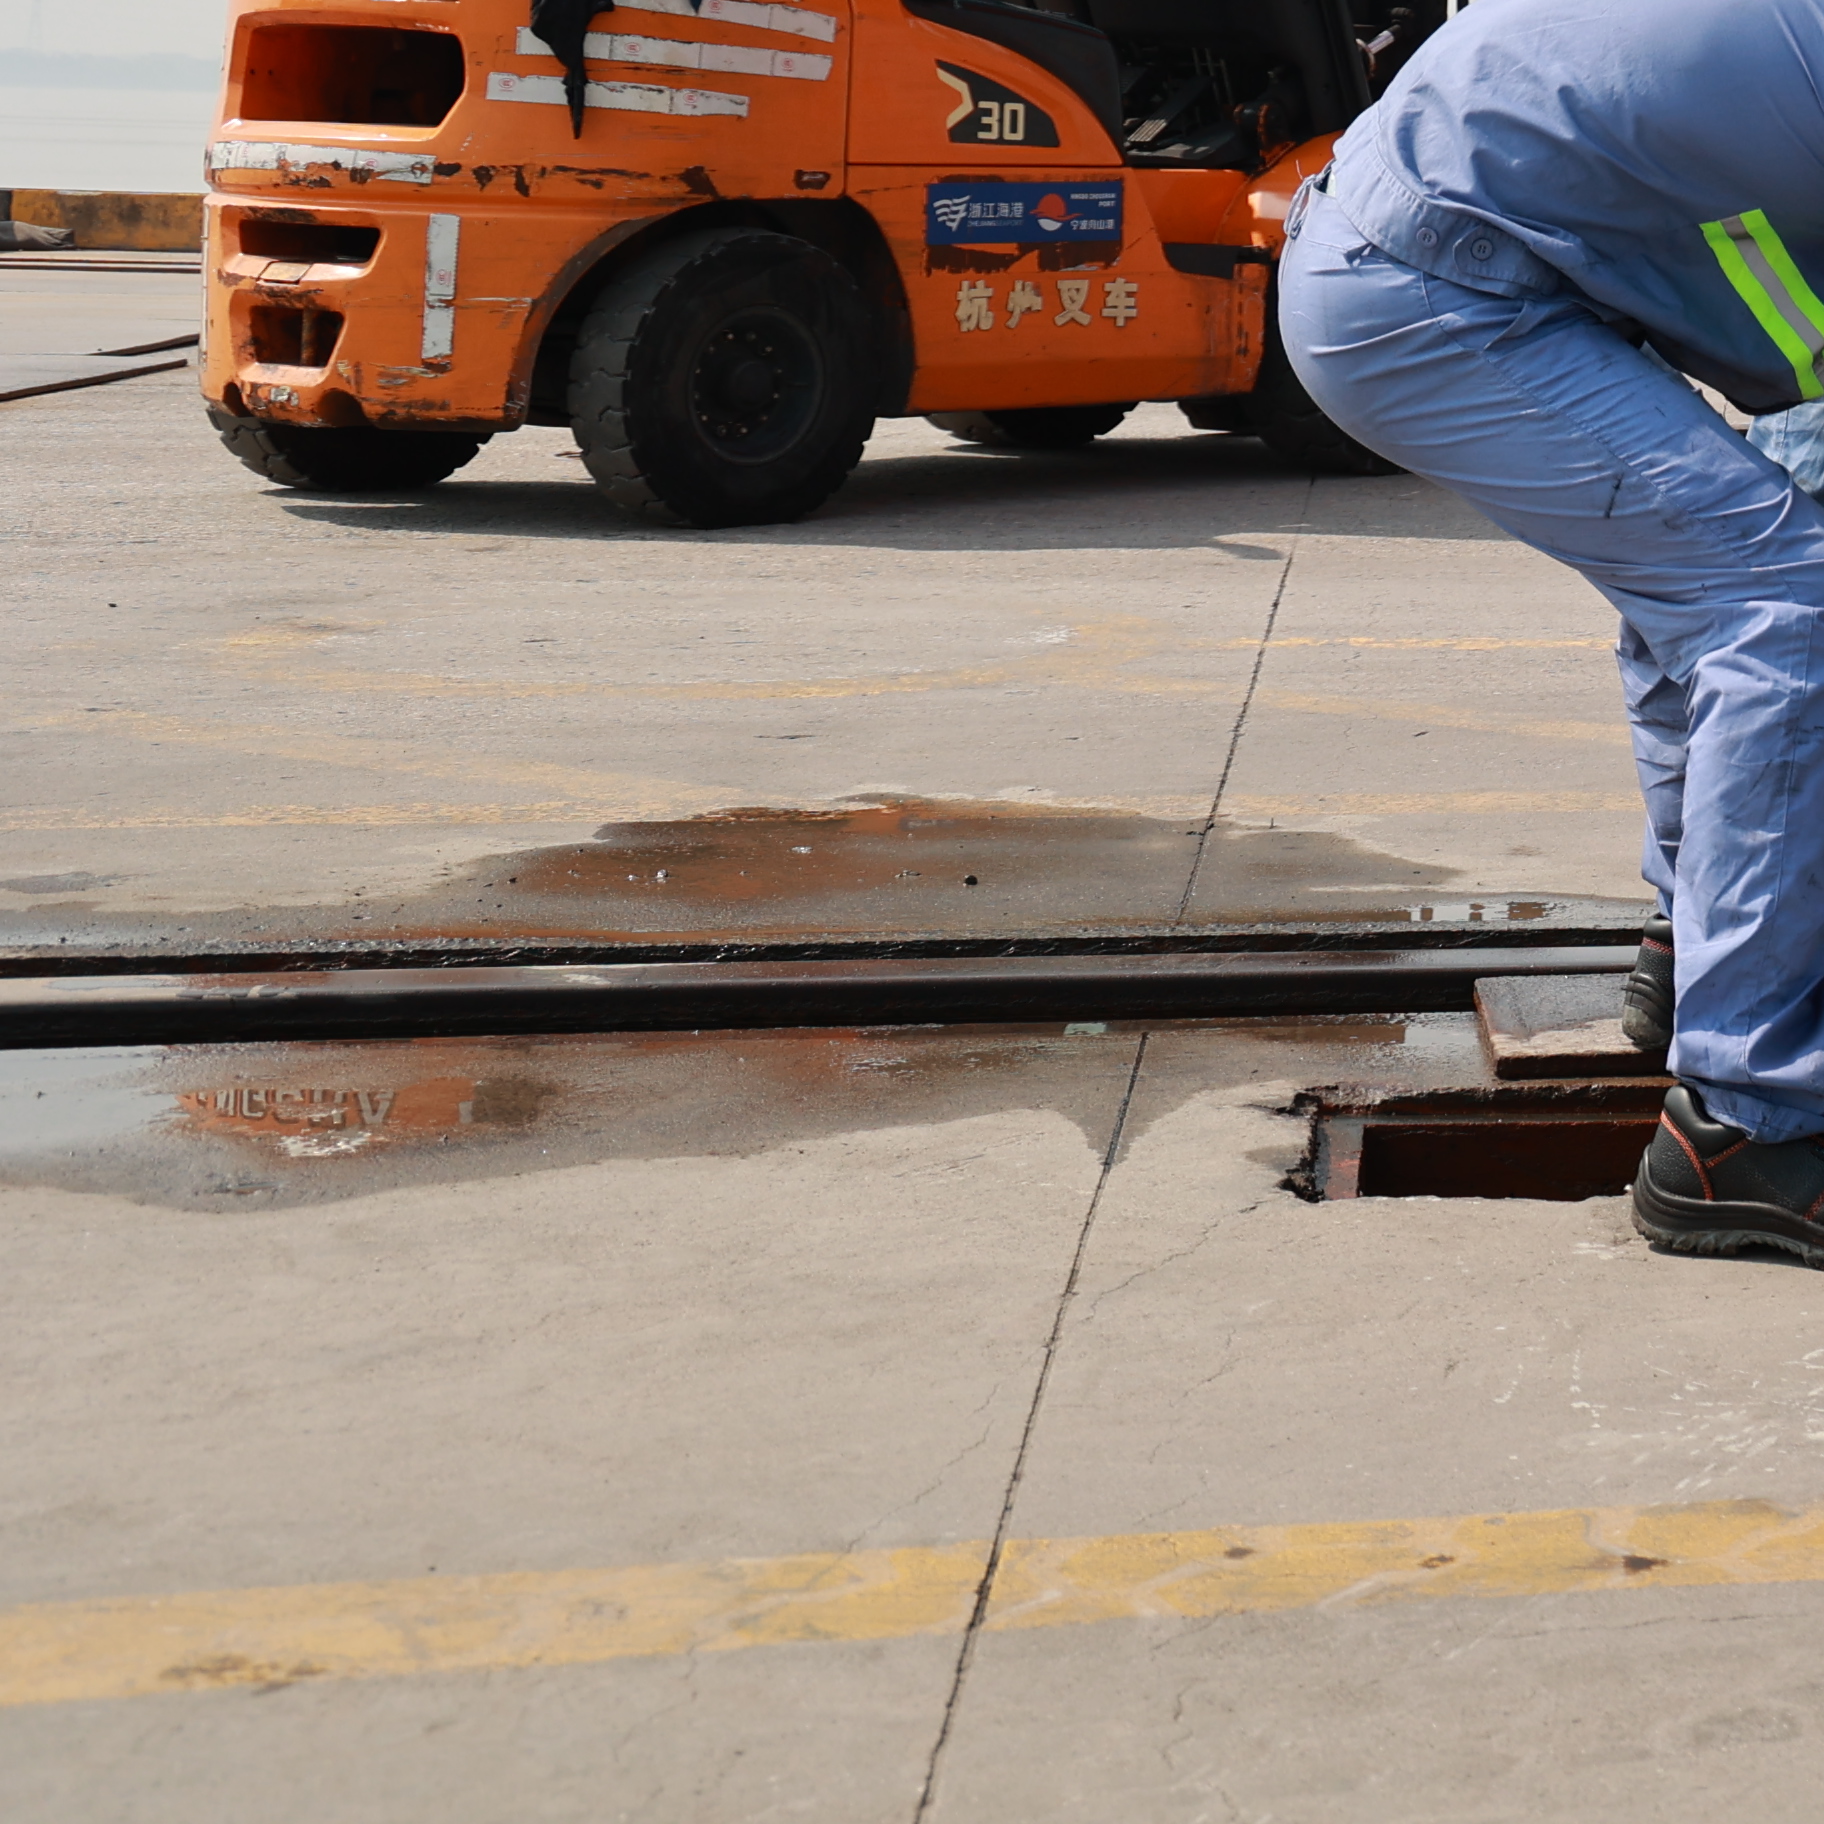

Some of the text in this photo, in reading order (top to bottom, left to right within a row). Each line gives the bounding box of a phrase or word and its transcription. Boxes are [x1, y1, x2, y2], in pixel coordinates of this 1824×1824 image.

[977, 101, 1026, 140] 30
[967, 202, 1024, 218] 浙江海港
